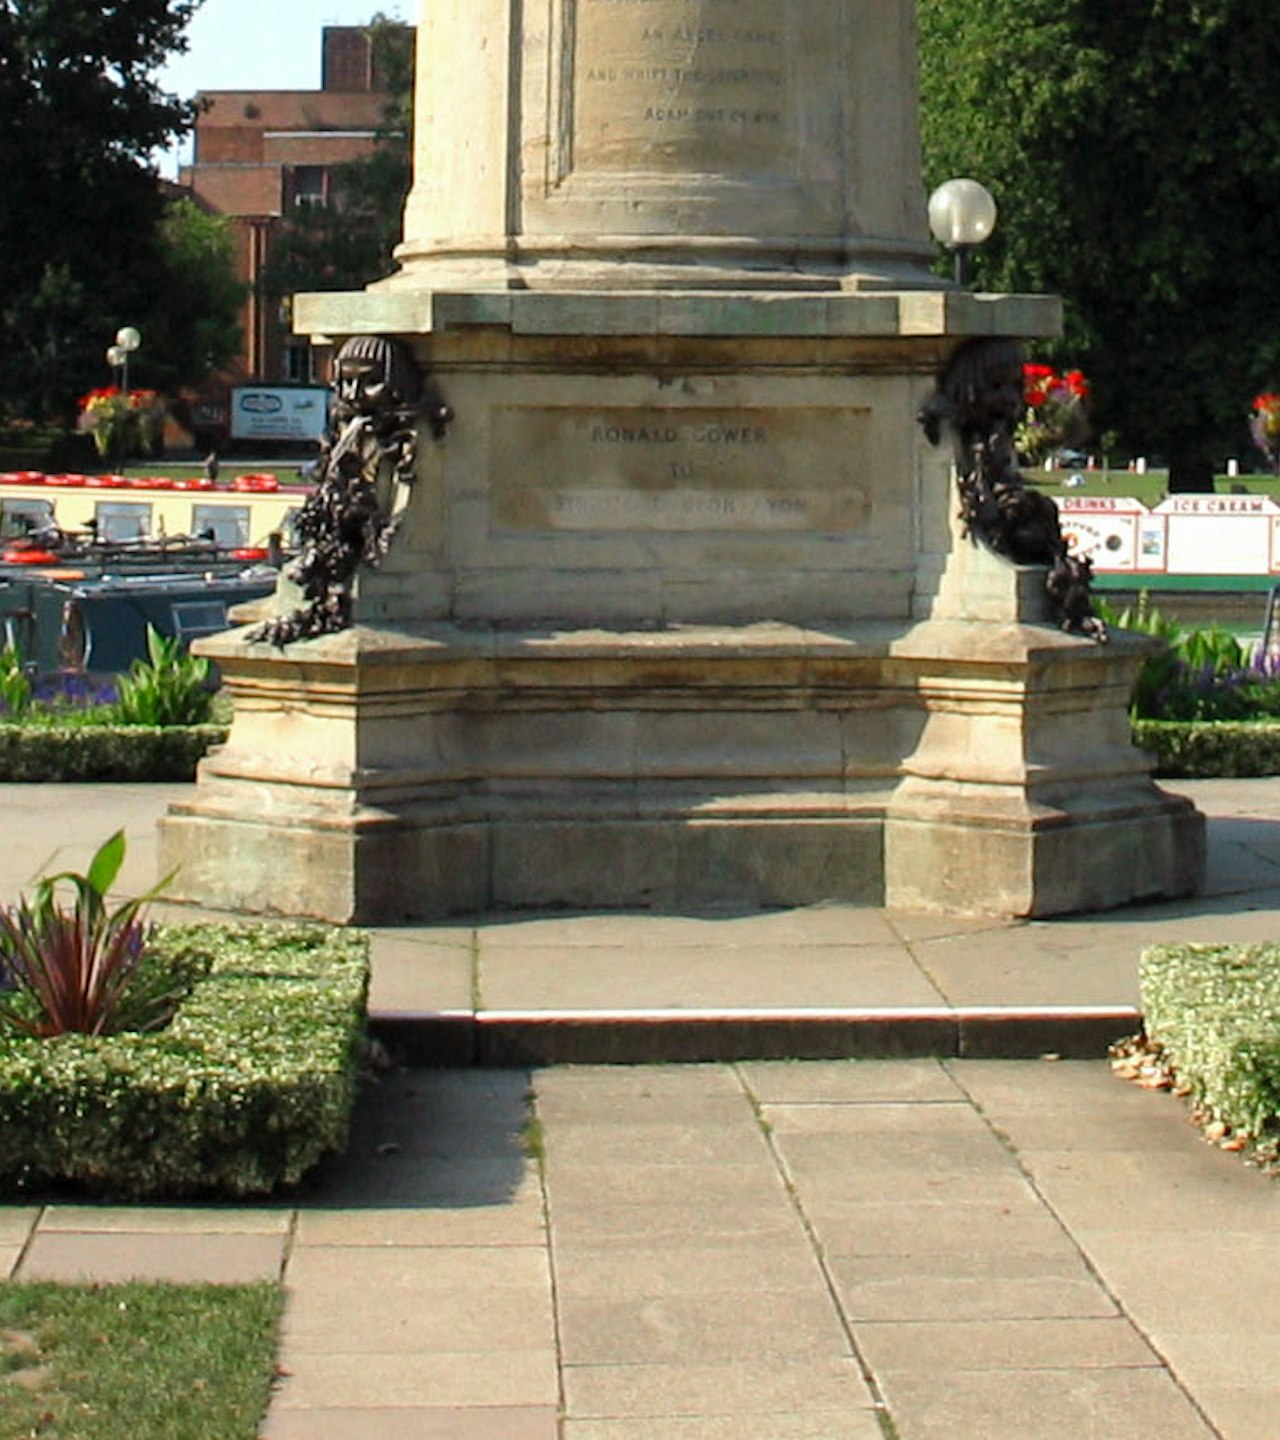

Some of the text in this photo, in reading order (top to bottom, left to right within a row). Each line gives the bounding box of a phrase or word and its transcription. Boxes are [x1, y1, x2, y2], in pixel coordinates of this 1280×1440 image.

[591, 426, 678, 442] RONALD
[670, 461, 693, 478] TO
[1064, 498, 1116, 510] DRINKS
[1174, 500, 1264, 512] ICE CREAM
